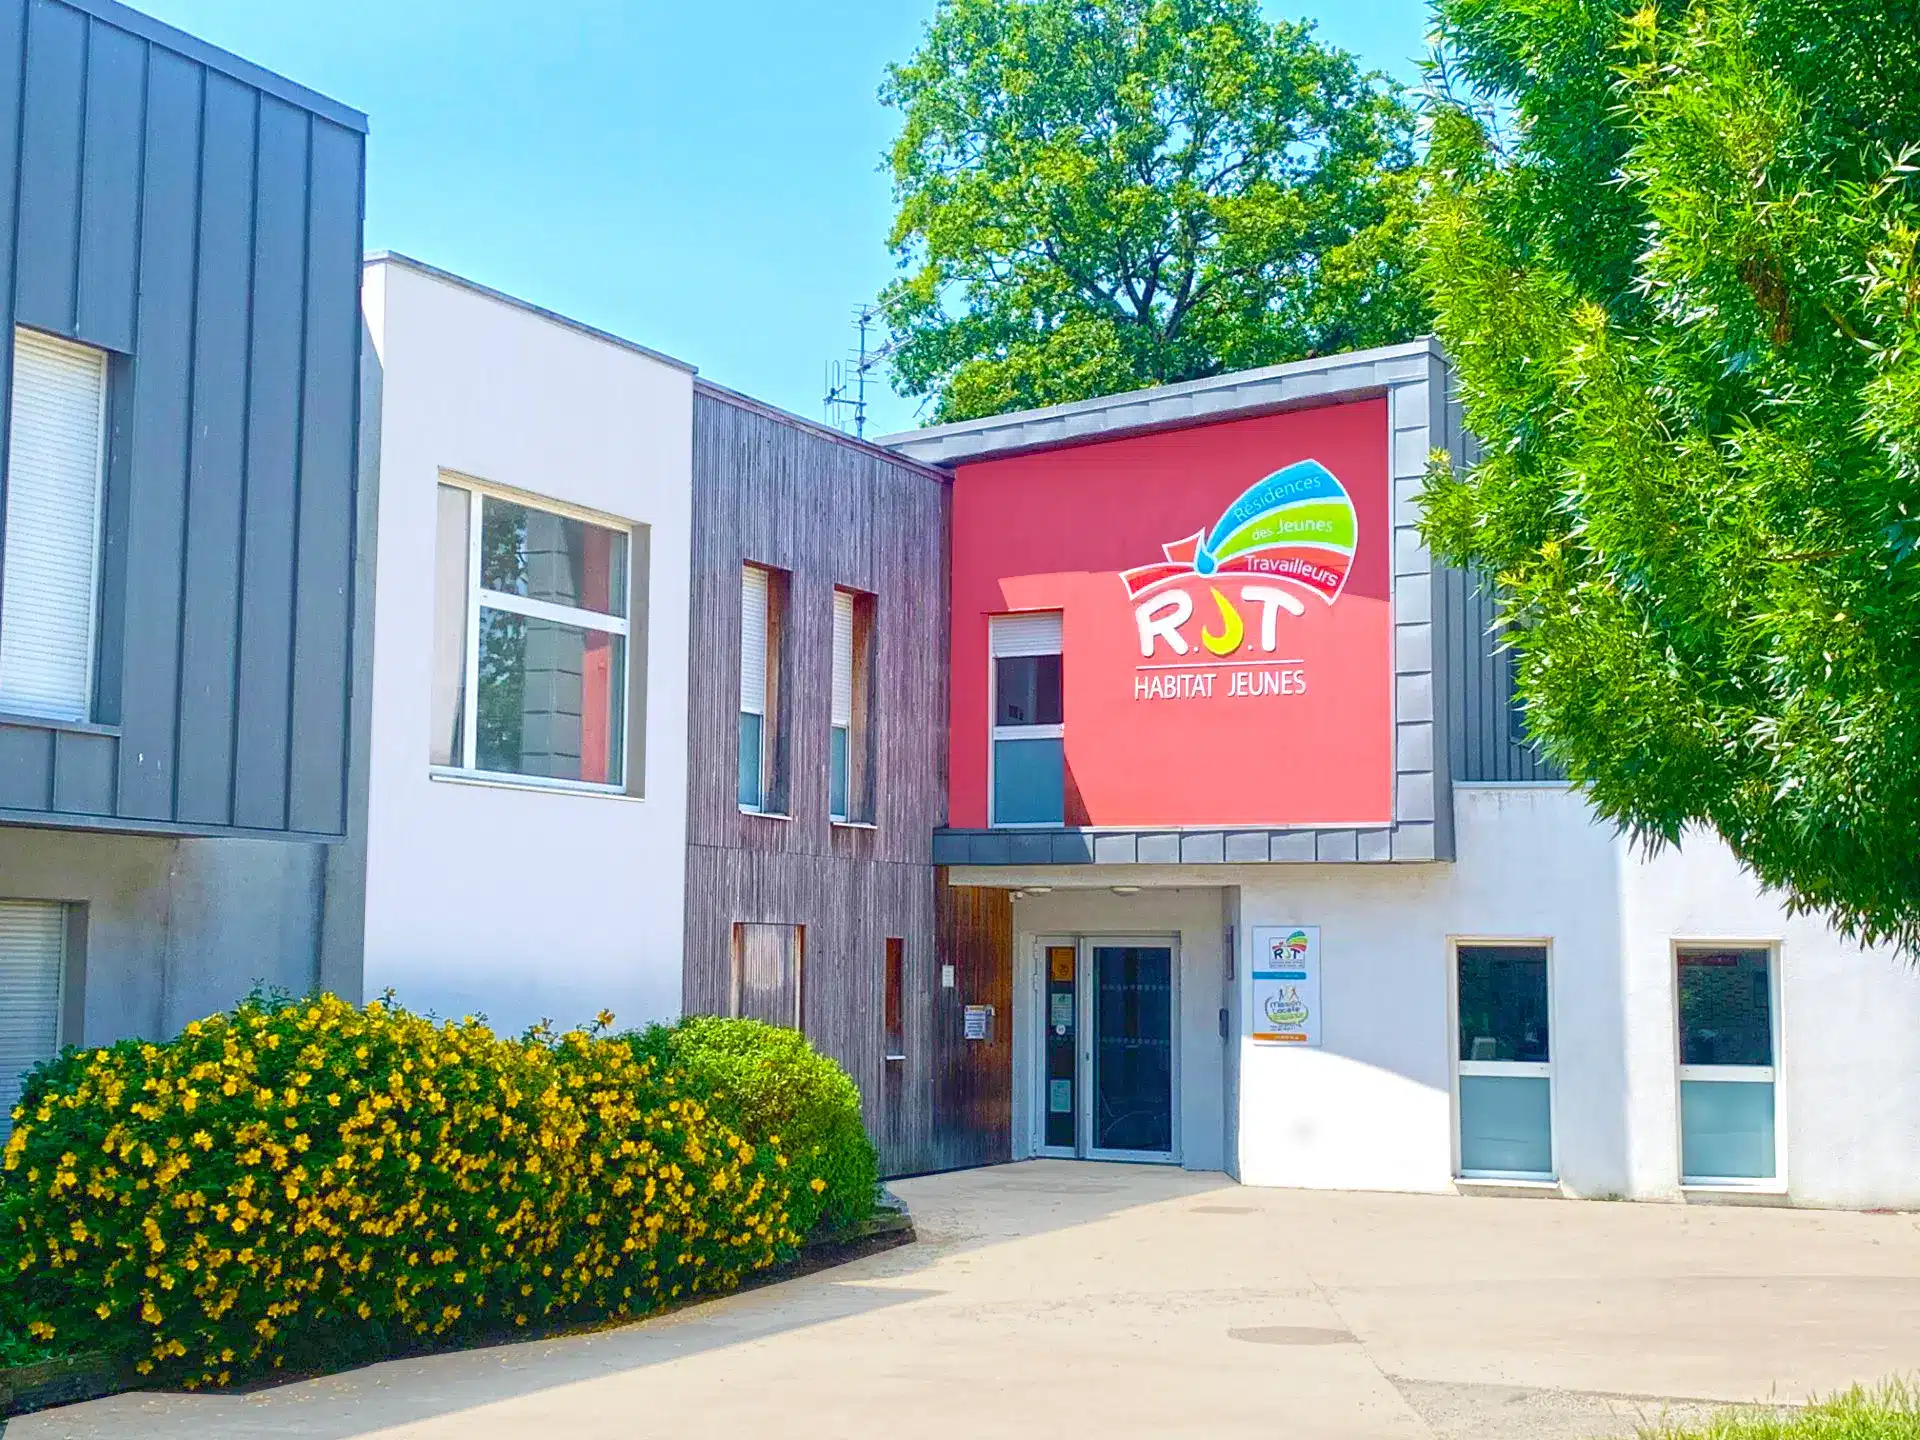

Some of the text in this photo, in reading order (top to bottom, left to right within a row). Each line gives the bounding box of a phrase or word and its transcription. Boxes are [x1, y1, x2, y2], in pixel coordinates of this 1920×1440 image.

[1233, 474, 1322, 522] Résidences
[1252, 518, 1333, 541] des Jeunes
[1244, 555, 1338, 586] Travailleurs
[1134, 669, 1307, 700] HABITAT JEUNES
